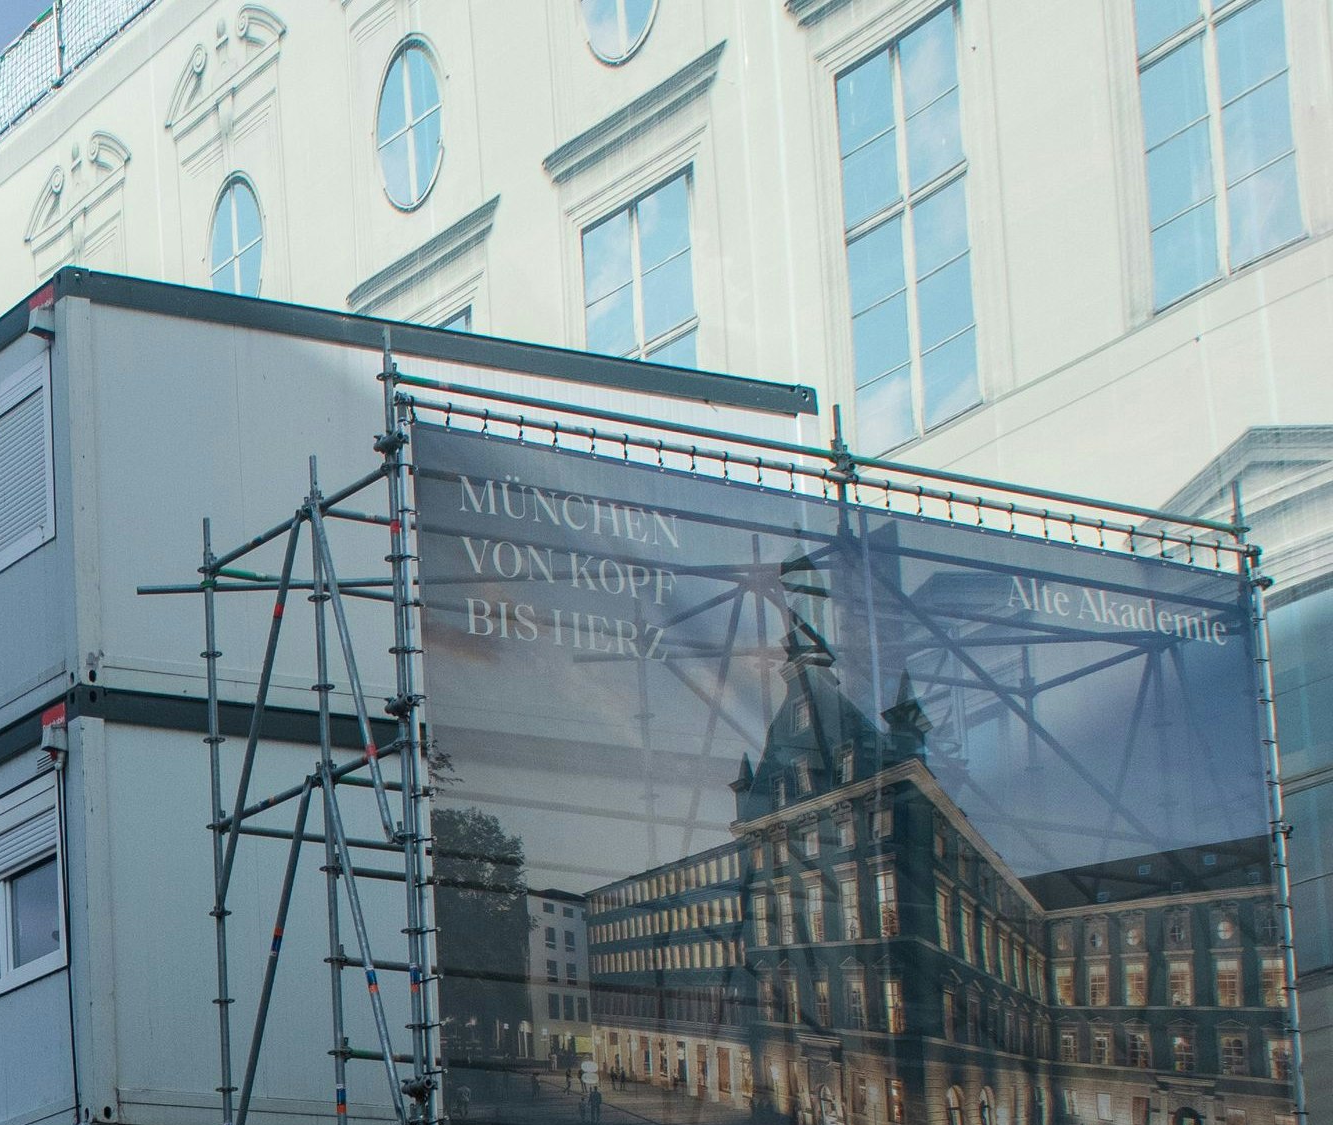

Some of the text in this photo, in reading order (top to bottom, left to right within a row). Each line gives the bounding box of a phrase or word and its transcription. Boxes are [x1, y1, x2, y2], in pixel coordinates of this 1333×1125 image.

[459, 473, 680, 550] MÜNCHEN
[461, 536, 678, 608] VON KOPF
[465, 597, 670, 664] BIS HERZ
[1007, 574, 1230, 647] Alte Akademie
